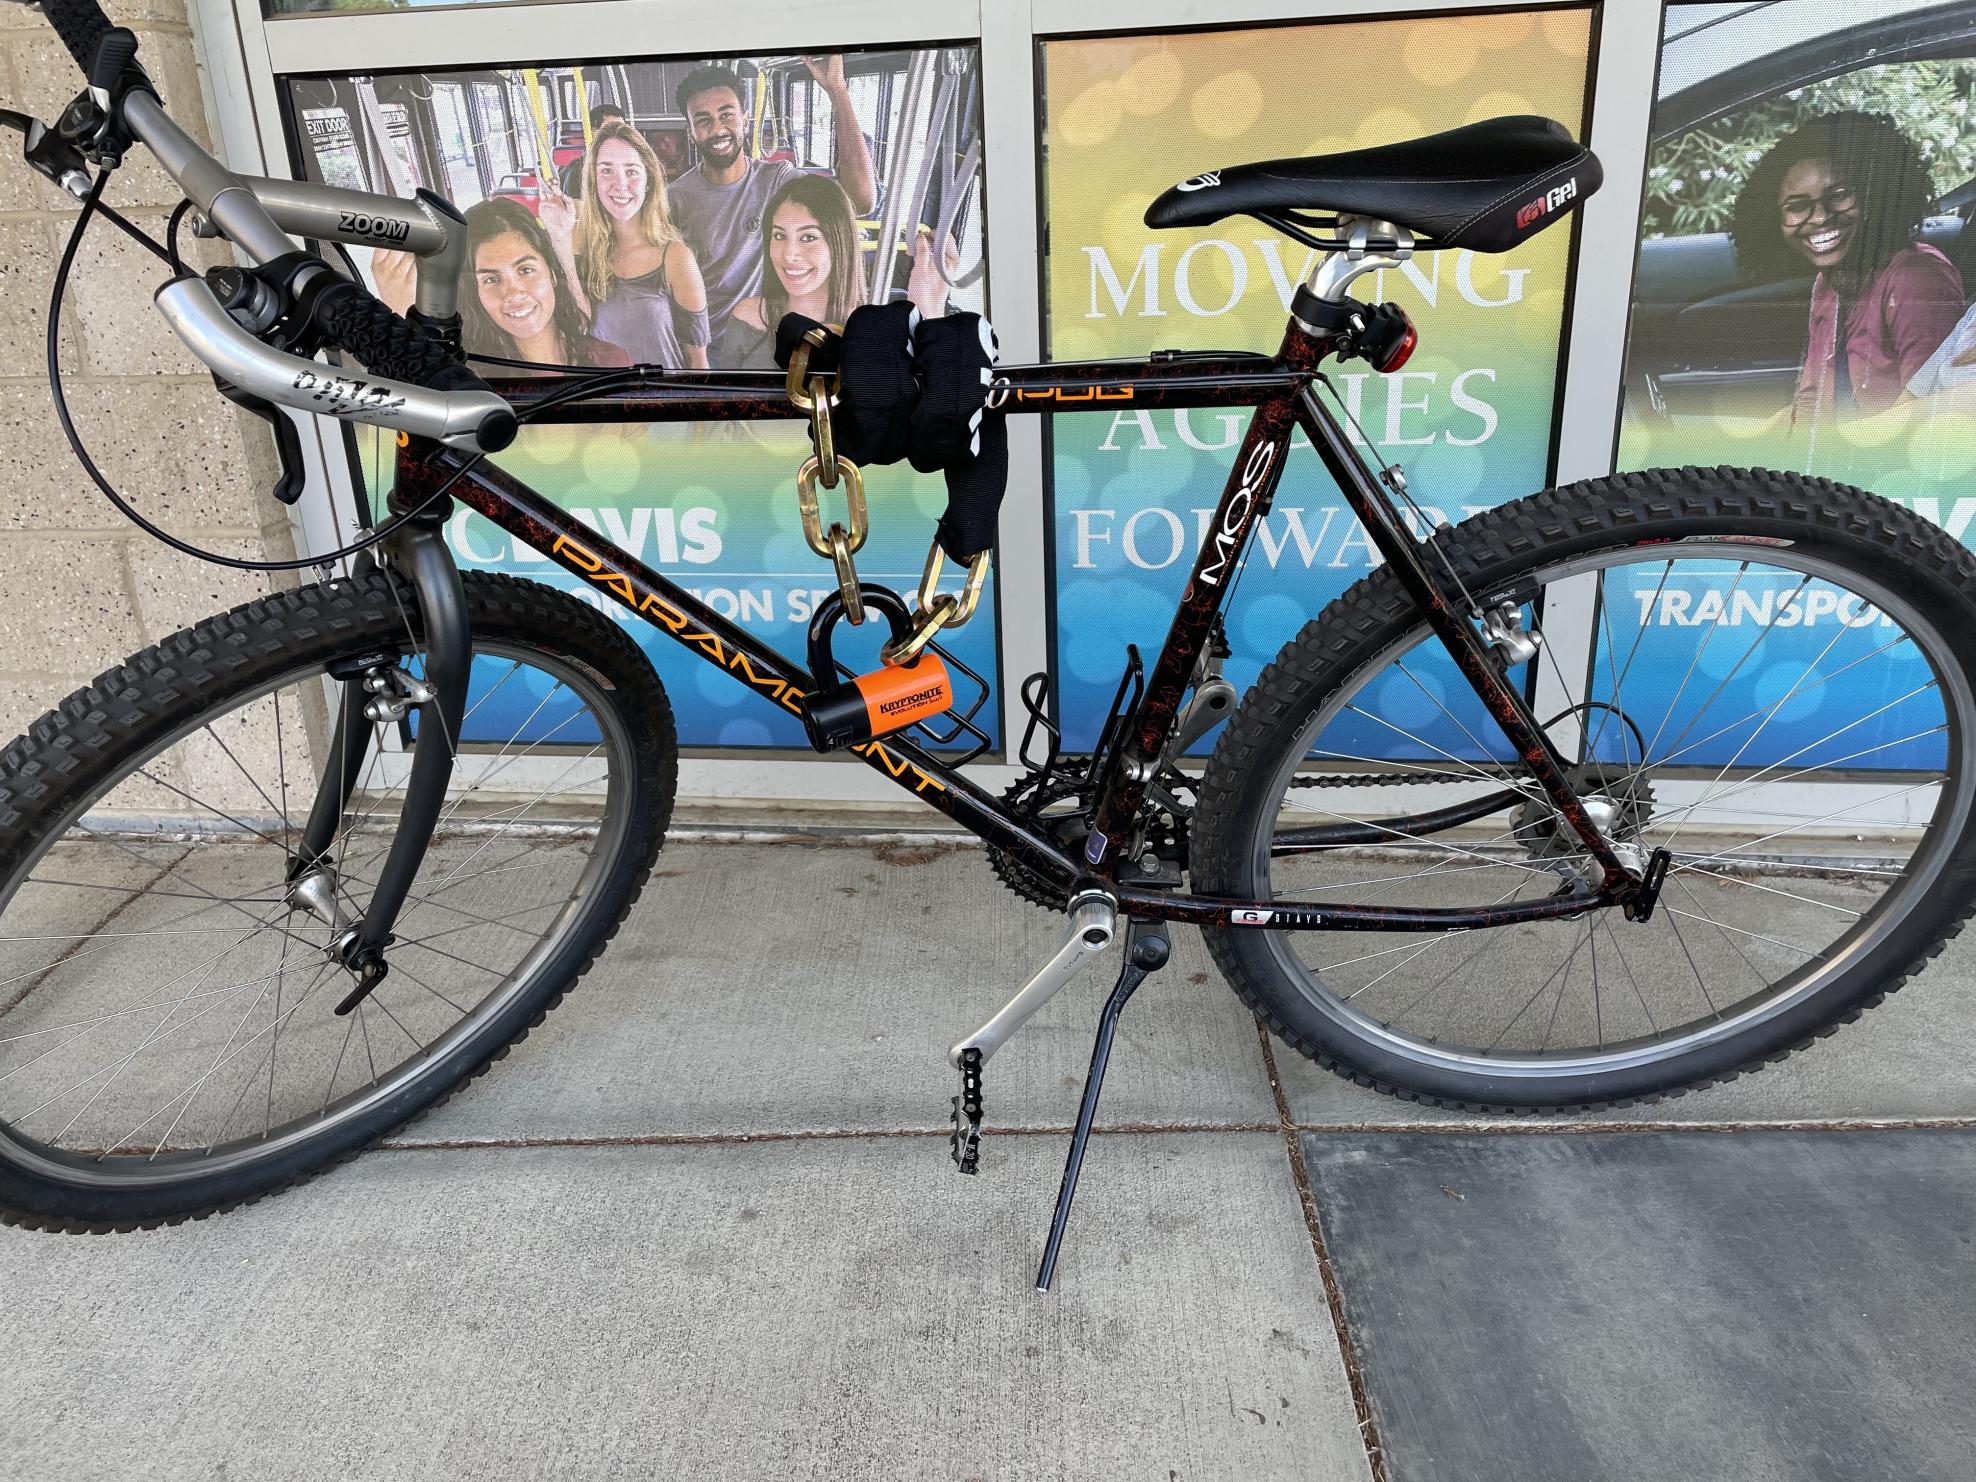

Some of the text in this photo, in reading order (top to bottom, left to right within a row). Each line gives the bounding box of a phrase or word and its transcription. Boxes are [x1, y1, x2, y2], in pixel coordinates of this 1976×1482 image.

[305, 117, 349, 135] EXIT DOOR
[338, 210, 410, 241] ZOOM
[1200, 440, 1275, 586] MOS
[879, 686, 944, 715] KRYPTONITE
[890, 698, 928, 717] EVOLUTION
